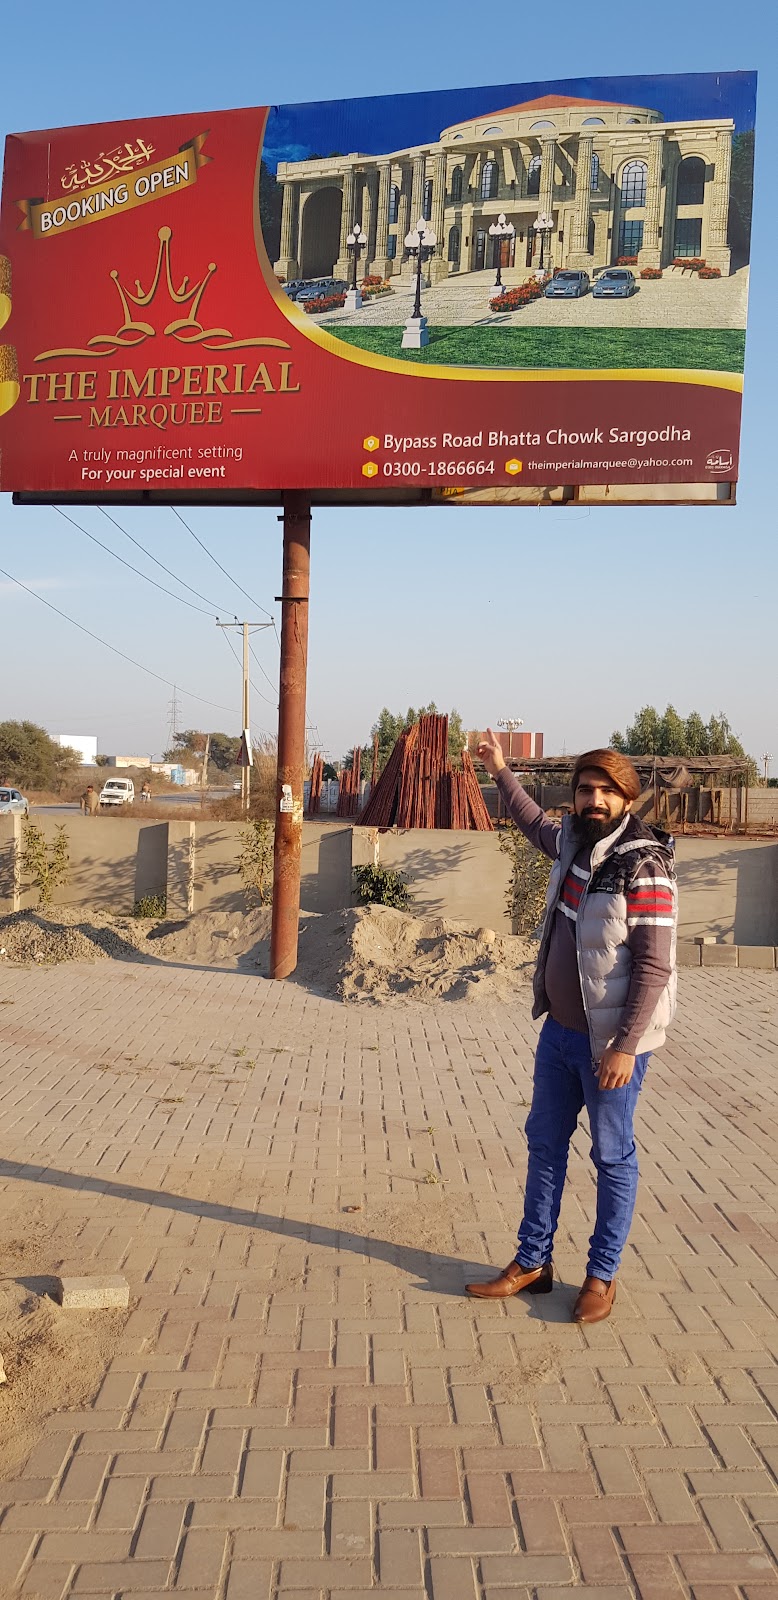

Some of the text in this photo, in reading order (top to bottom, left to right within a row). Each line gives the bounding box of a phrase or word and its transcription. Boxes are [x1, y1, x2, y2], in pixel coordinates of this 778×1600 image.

[40, 160, 190, 233] BOOKING OPEN
[23, 361, 300, 402] THE IMPERIAL
[88, 402, 223, 430] MARQUEE
[383, 426, 691, 453] Bypass Road Bhatta Chowk Sargodha
[68, 445, 243, 464] A truly magnificent setting
[528, 458, 693, 471] theimperialmarquee@yahoo.com
[81, 464, 226, 482] For your special event
[383, 460, 495, 477] 0300-1866664
